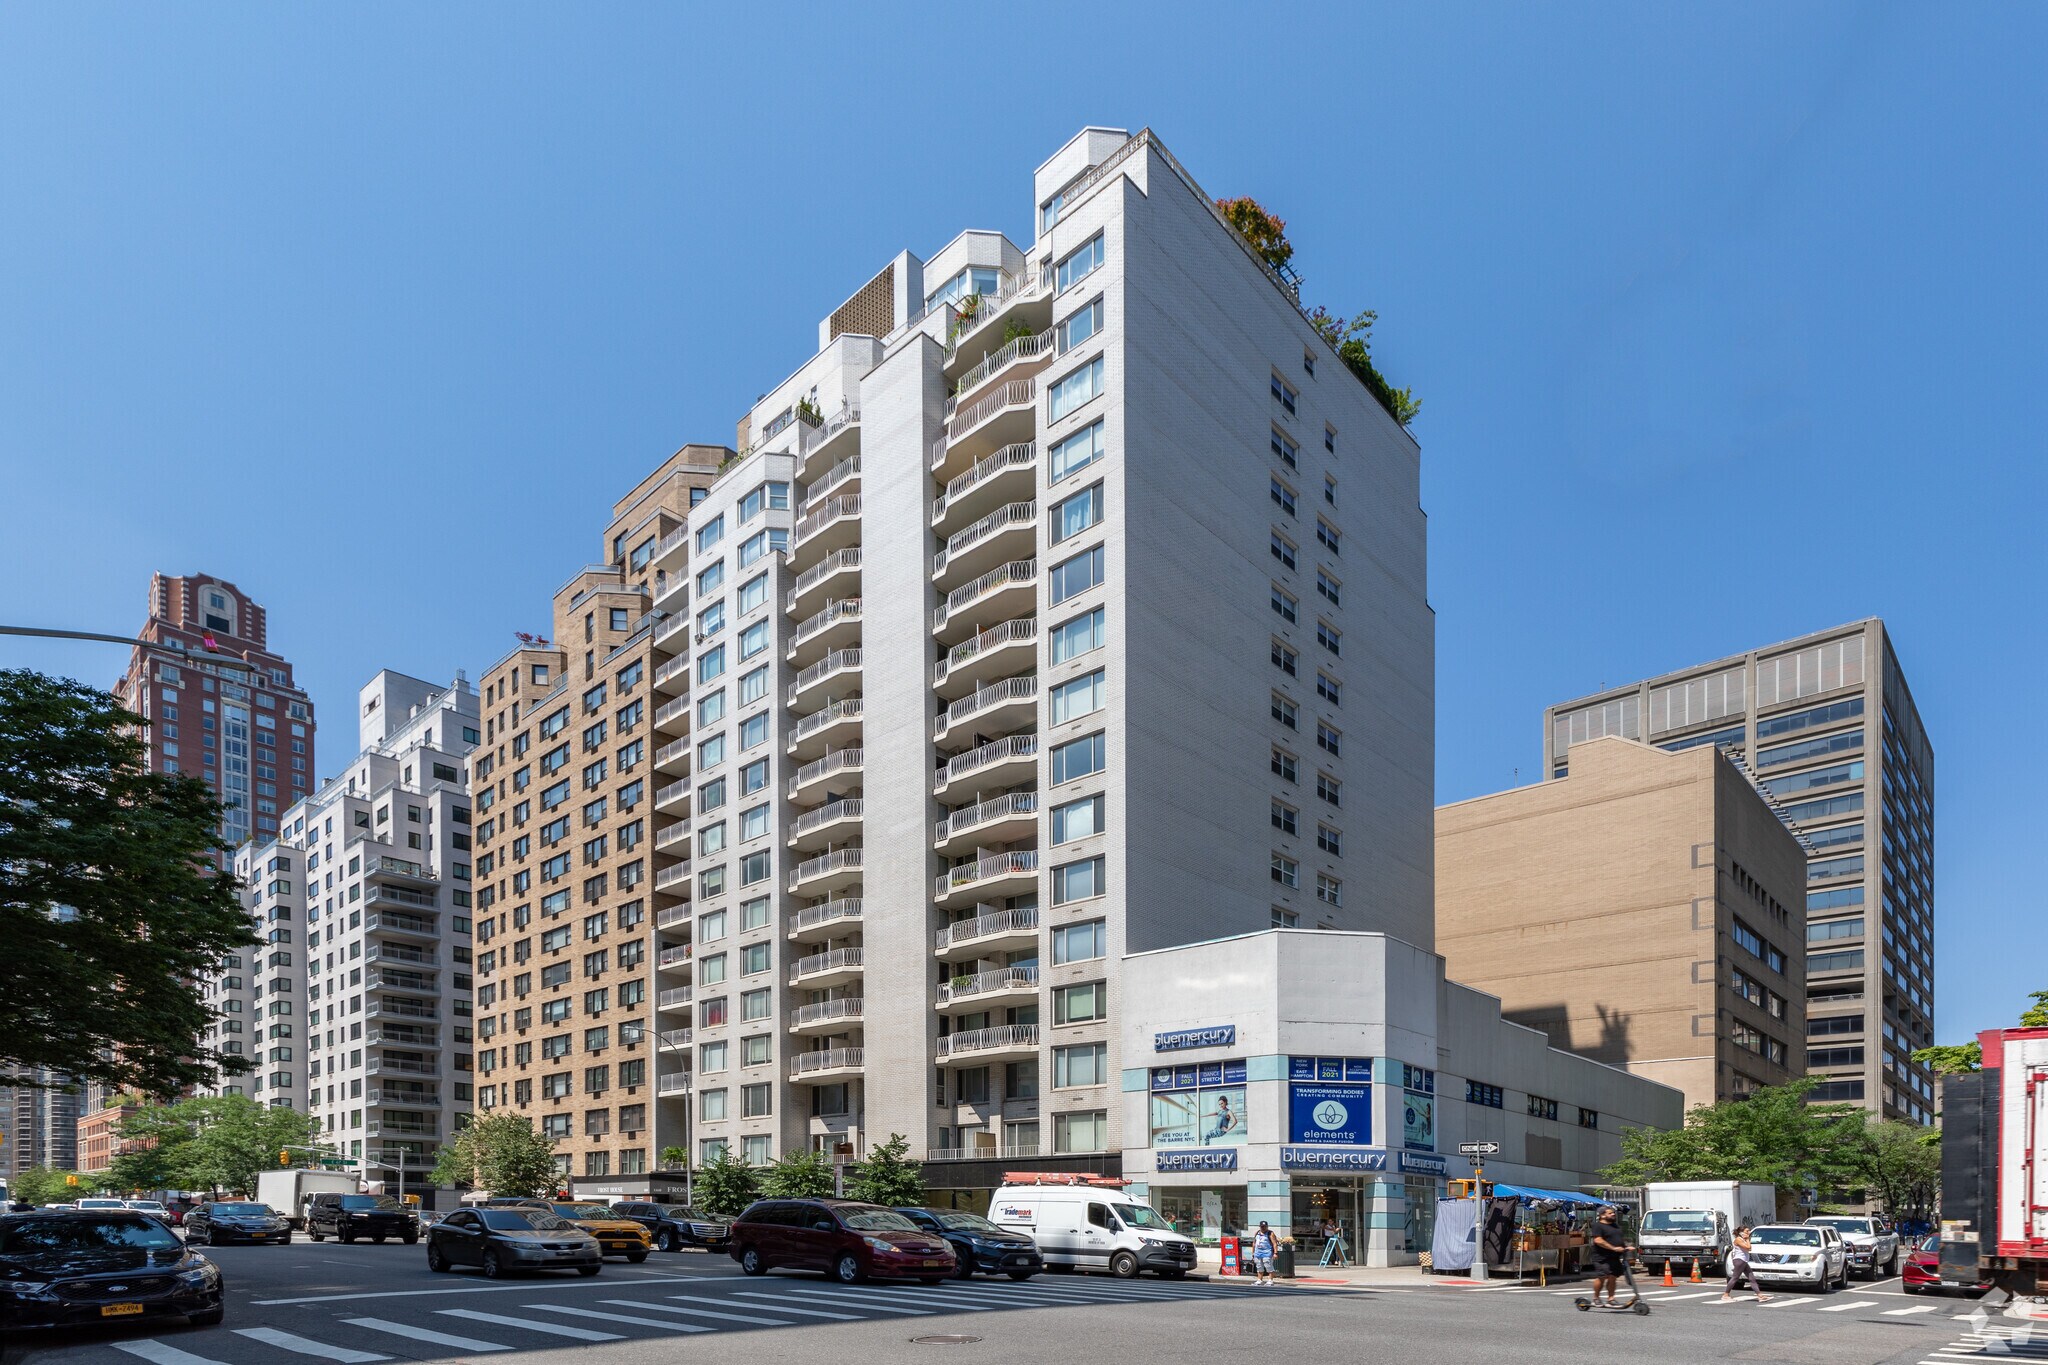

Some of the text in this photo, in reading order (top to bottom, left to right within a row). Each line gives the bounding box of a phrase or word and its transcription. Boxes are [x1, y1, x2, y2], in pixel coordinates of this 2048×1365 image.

[1154, 1028, 1232, 1046] bluemercury
[1303, 1130, 1355, 1139] elements
[1156, 1152, 1233, 1166] bluemercury
[1283, 1148, 1386, 1168] bluemercury
[1402, 1153, 1448, 1174] bluemercury
[1004, 1208, 1031, 1216] Trademark
